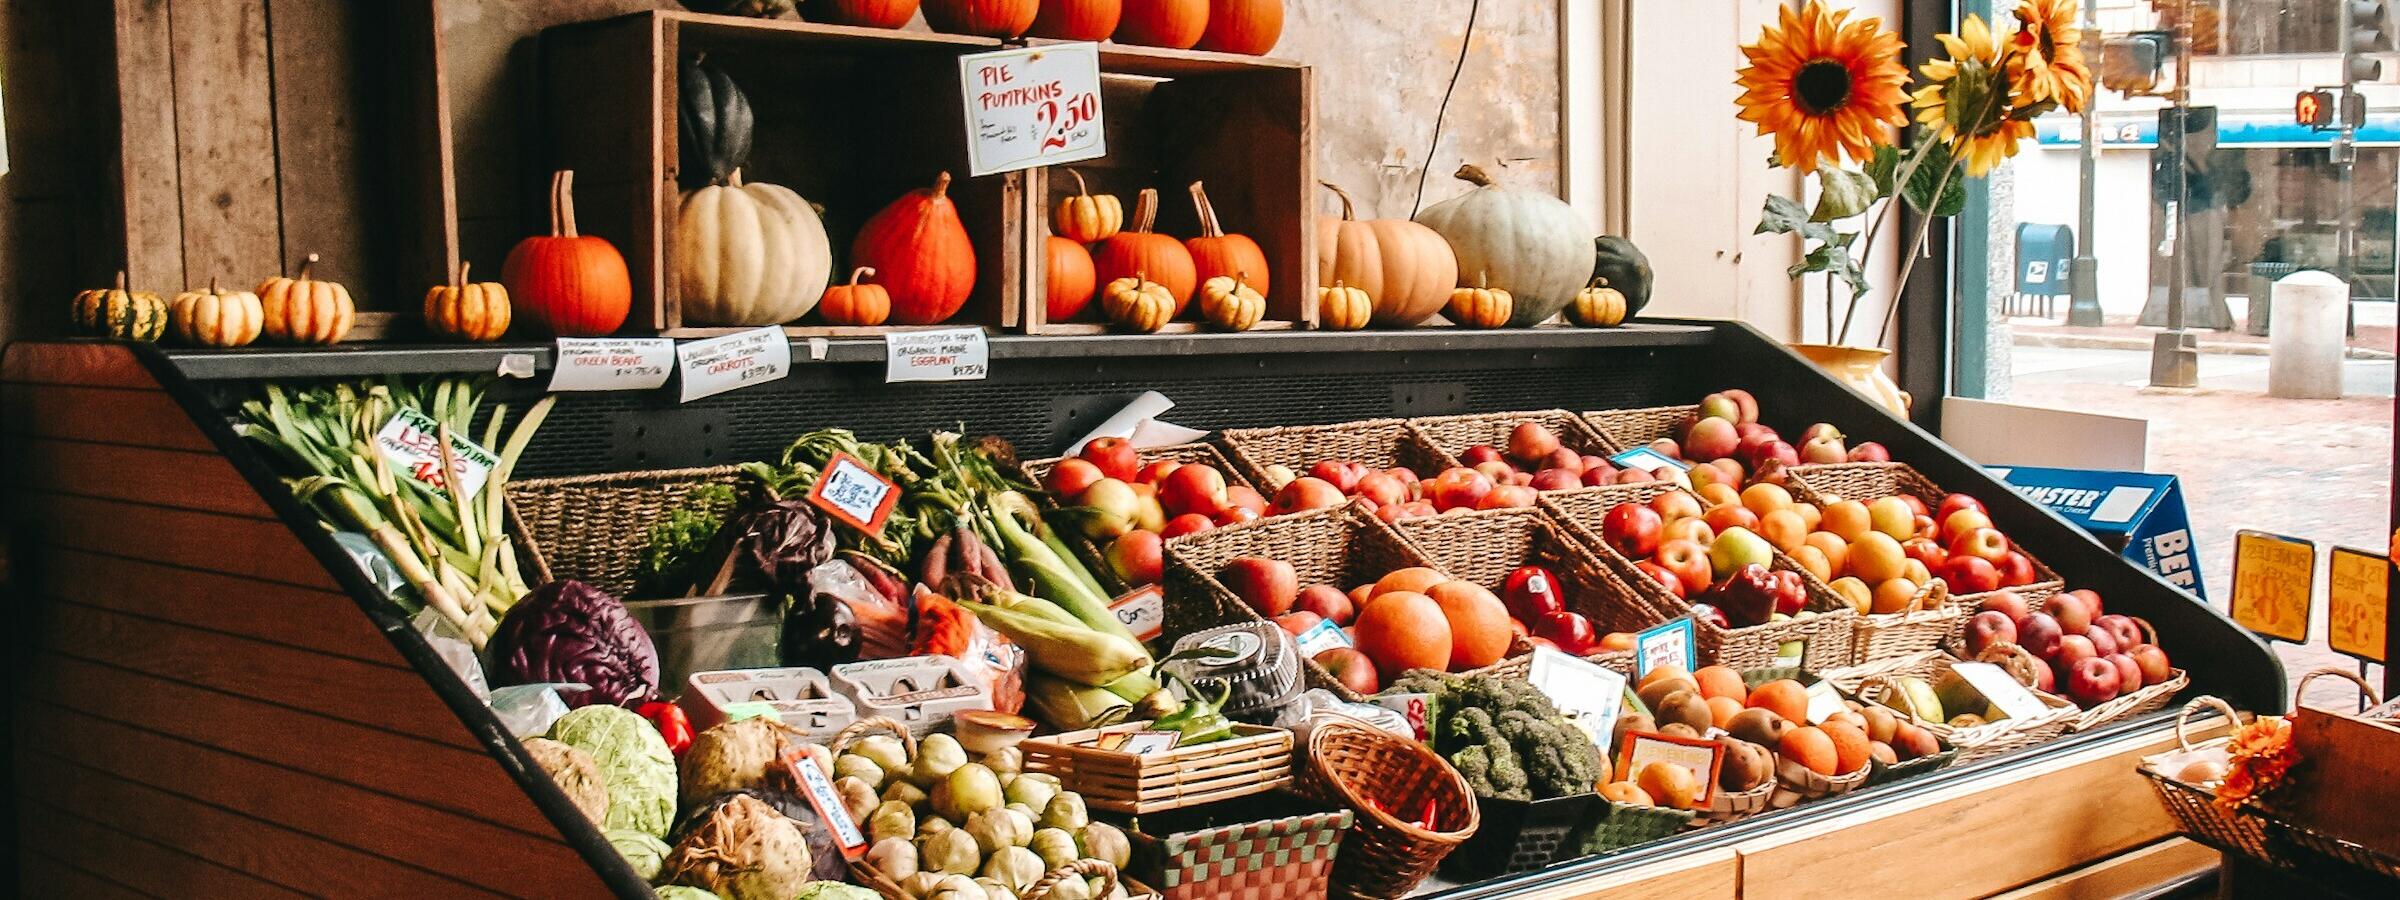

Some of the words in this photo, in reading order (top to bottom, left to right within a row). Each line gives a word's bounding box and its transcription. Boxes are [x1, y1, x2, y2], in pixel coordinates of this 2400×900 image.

[979, 64, 1014, 87] PIE
[978, 80, 1063, 111] PUMPKINS
[1037, 92, 1097, 155] 2.50
[574, 355, 609, 366] GREEN
[611, 355, 642, 366] BEANS
[708, 356, 755, 375] CARROTS
[911, 355, 960, 367] EGGPLANT
[400, 425, 468, 474] LEES
